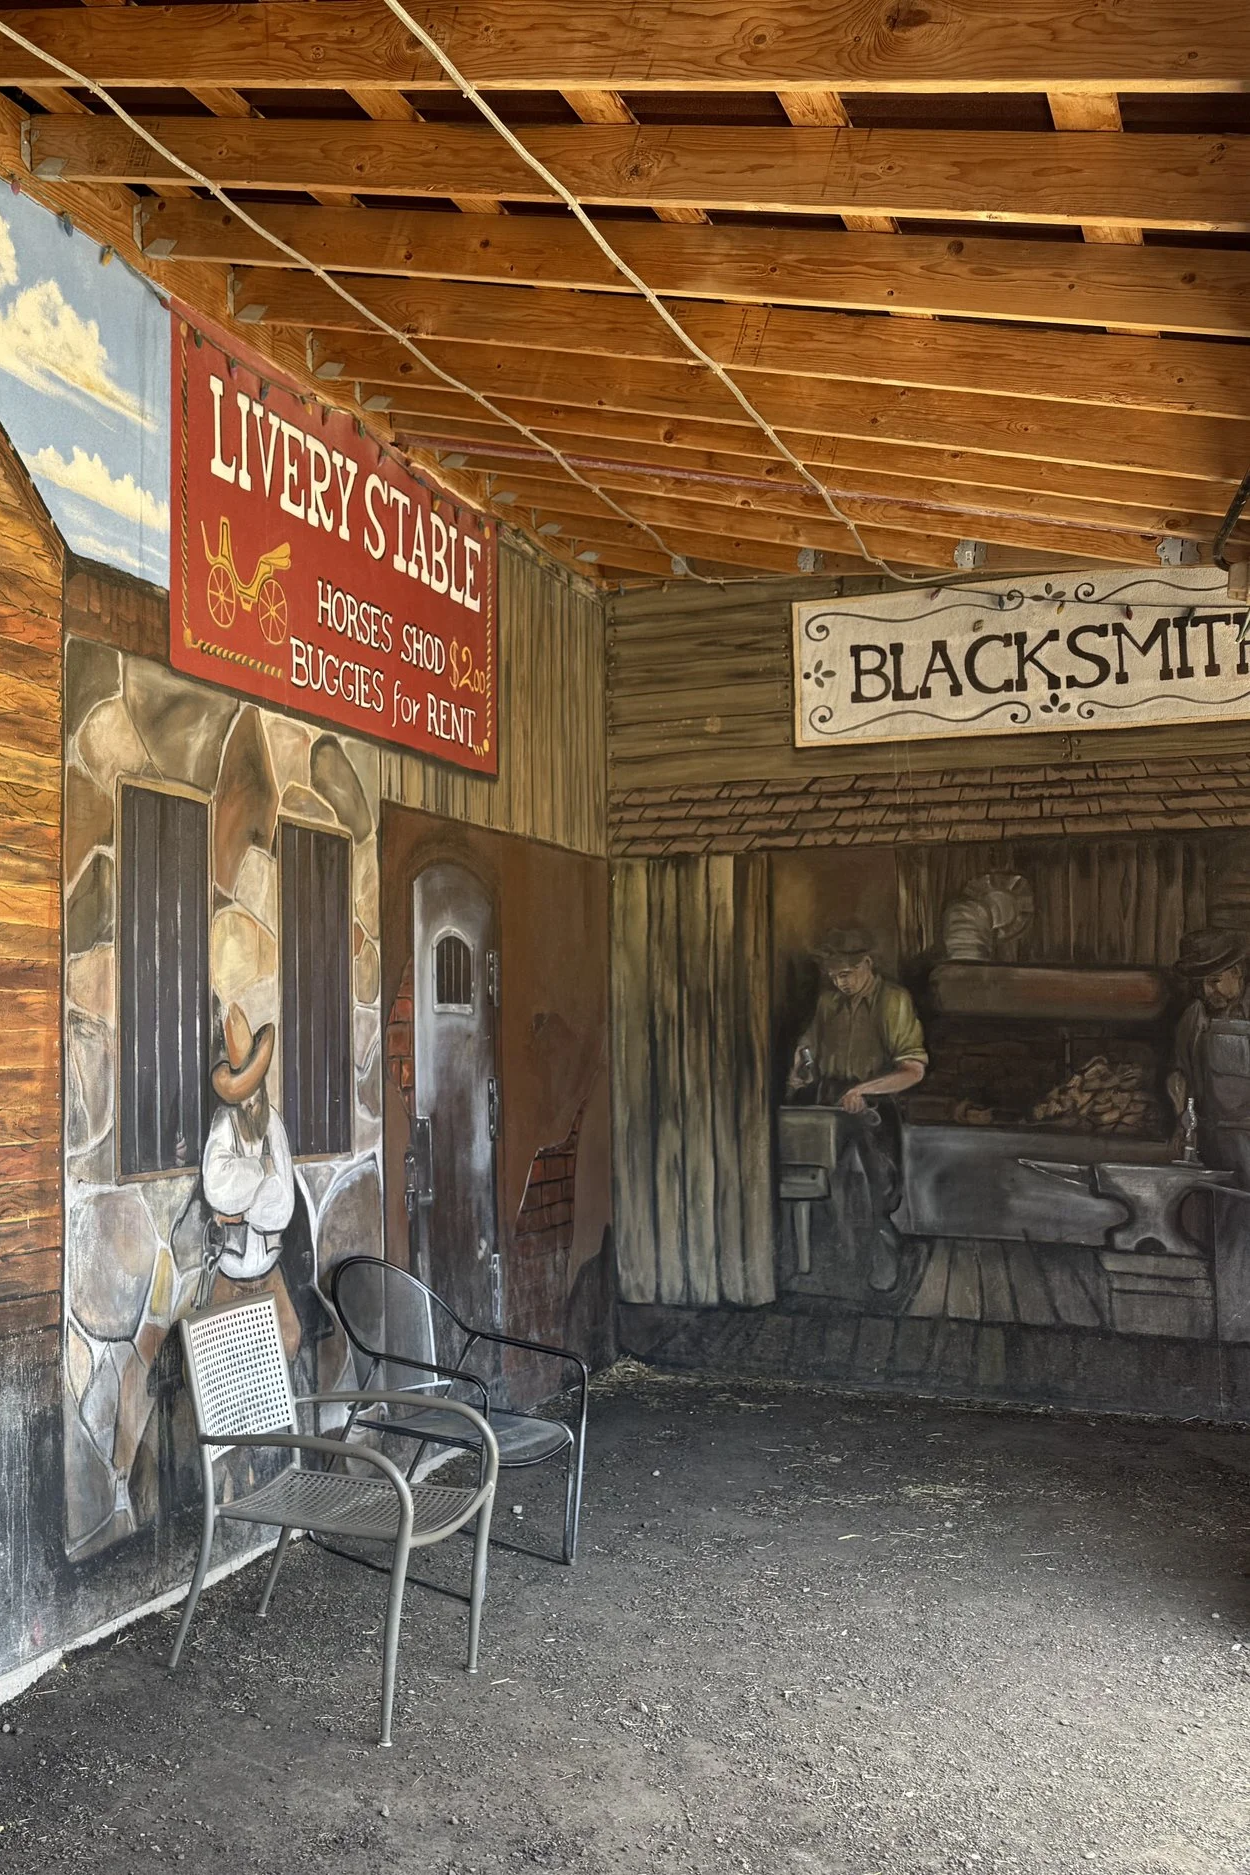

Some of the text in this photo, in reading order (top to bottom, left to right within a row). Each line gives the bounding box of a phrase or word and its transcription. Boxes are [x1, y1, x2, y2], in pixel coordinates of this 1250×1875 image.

[209, 374, 482, 614] LIVERY STABLE
[289, 635, 476, 748] BUGGIES for RENT
[317, 578, 486, 694] HORSES SHOD $2.00
